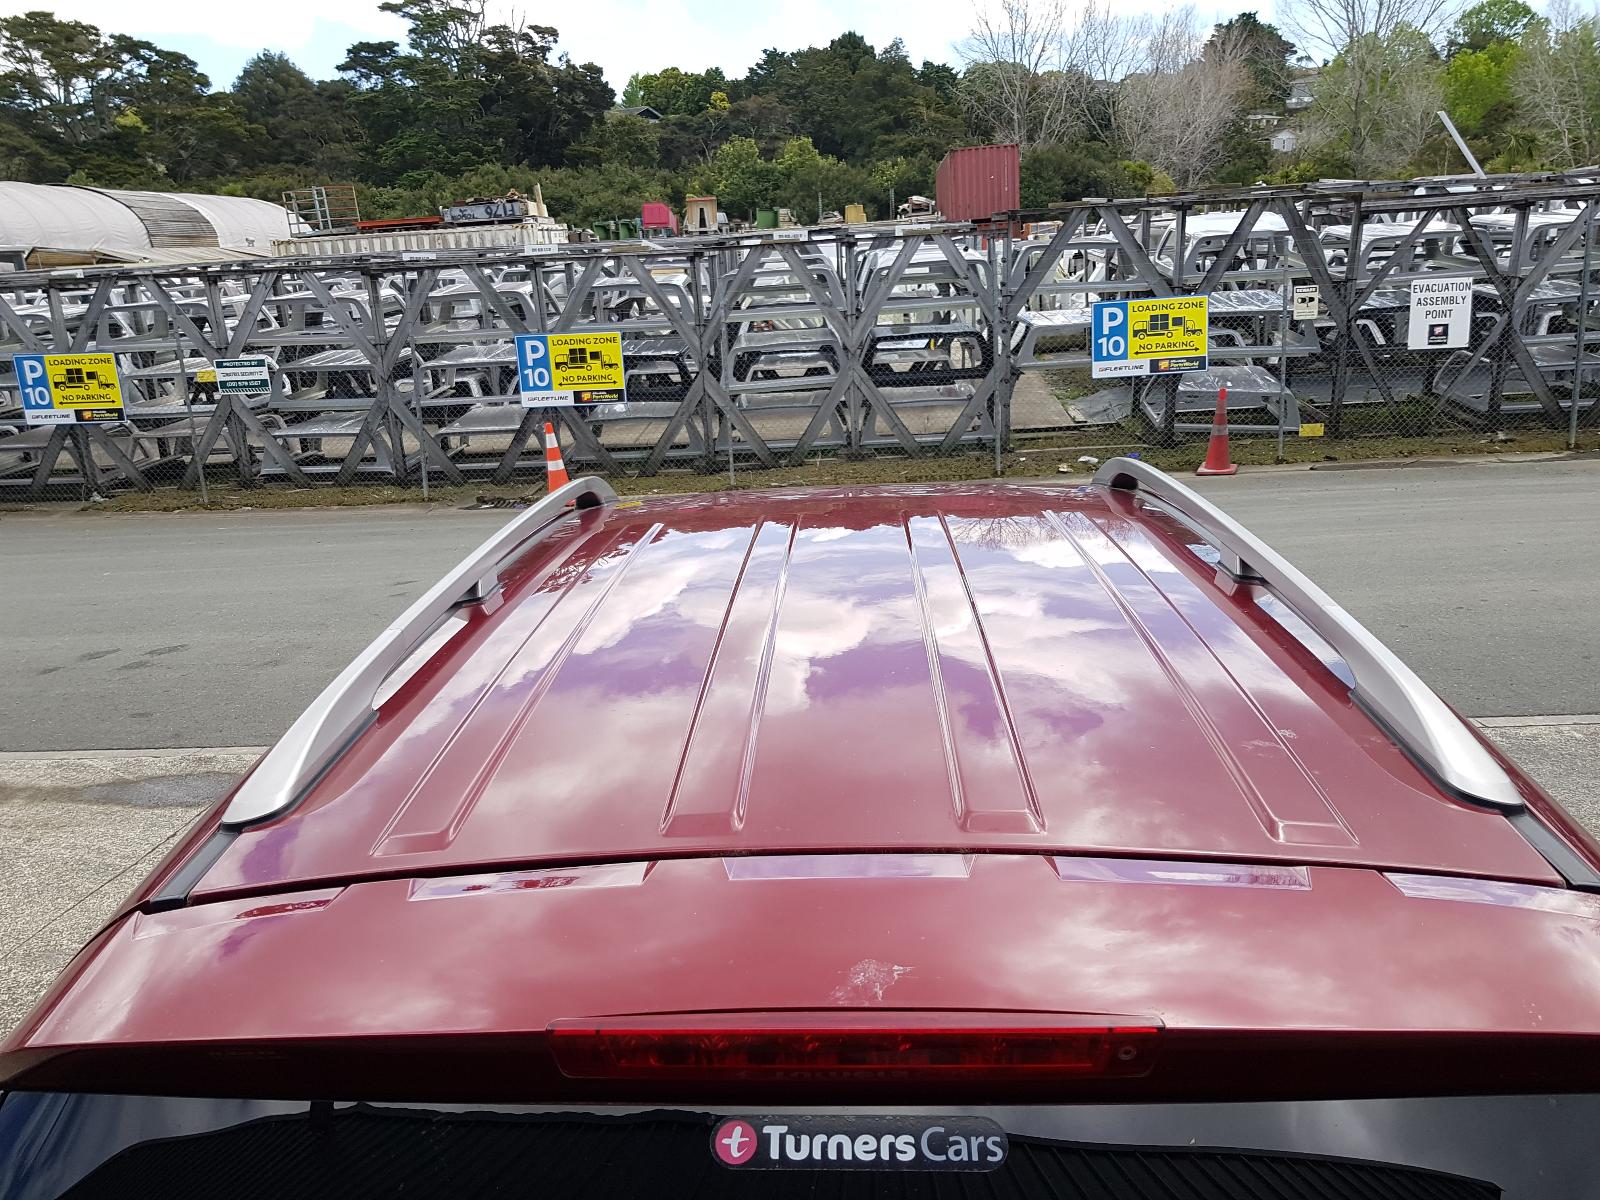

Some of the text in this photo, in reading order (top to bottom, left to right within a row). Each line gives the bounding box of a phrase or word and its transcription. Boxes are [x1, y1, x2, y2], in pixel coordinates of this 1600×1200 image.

[1413, 282, 1472, 293] EVACUATION
[1132, 301, 1204, 312] LOADING ZONE
[1416, 296, 1466, 306] ASSEMBLY
[1102, 308, 1123, 334] P
[1425, 309, 1453, 319] POINT
[552, 338, 592, 346] LOADING
[1098, 336, 1125, 357] 10
[1139, 341, 1194, 351] NO PARKING
[525, 340, 545, 366] P
[23, 360, 43, 385] P
[524, 368, 550, 387] 10
[577, 374, 612, 382] PARKING
[24, 386, 50, 406] 10
[762, 1125, 916, 1161] Turners
[920, 1126, 1004, 1162] Cars
